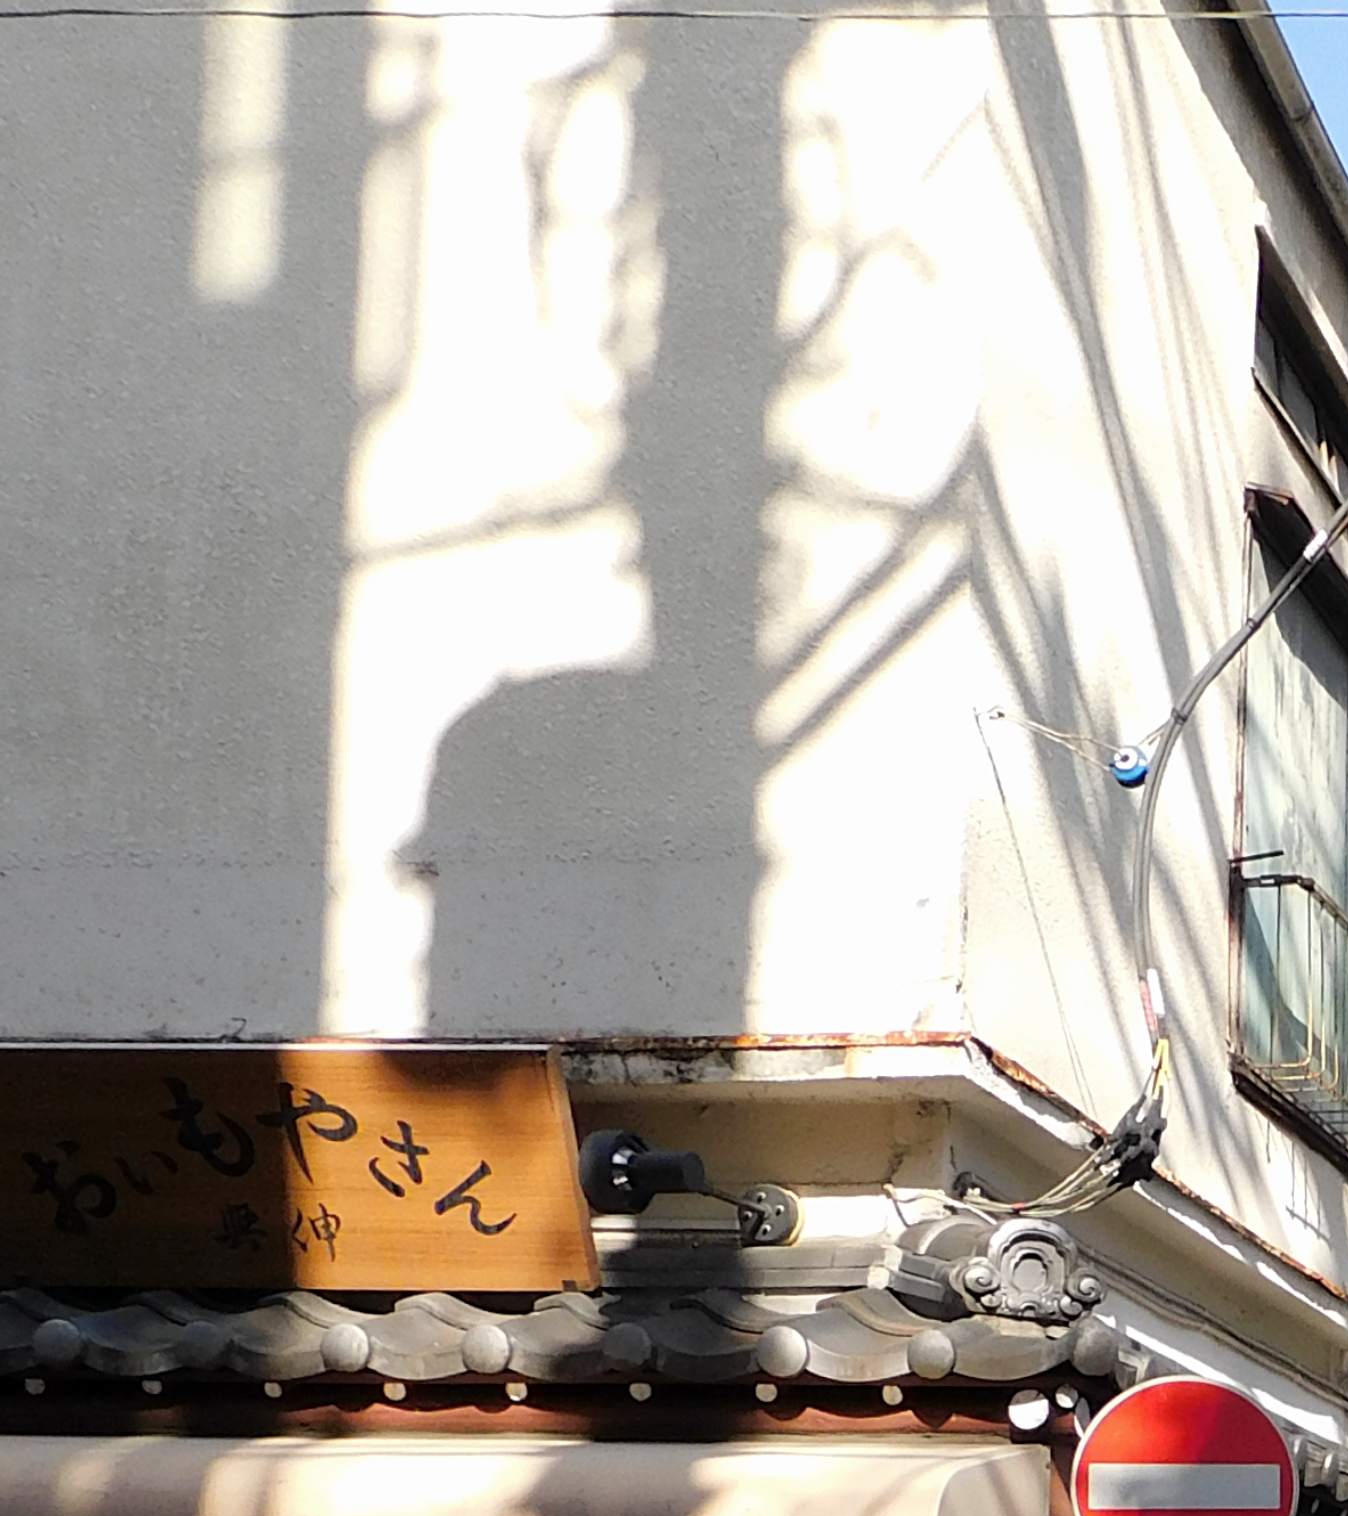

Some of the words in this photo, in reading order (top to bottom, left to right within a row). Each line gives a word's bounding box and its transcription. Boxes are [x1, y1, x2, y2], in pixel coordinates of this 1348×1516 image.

[22, 1077, 517, 1236] おいもやさん
